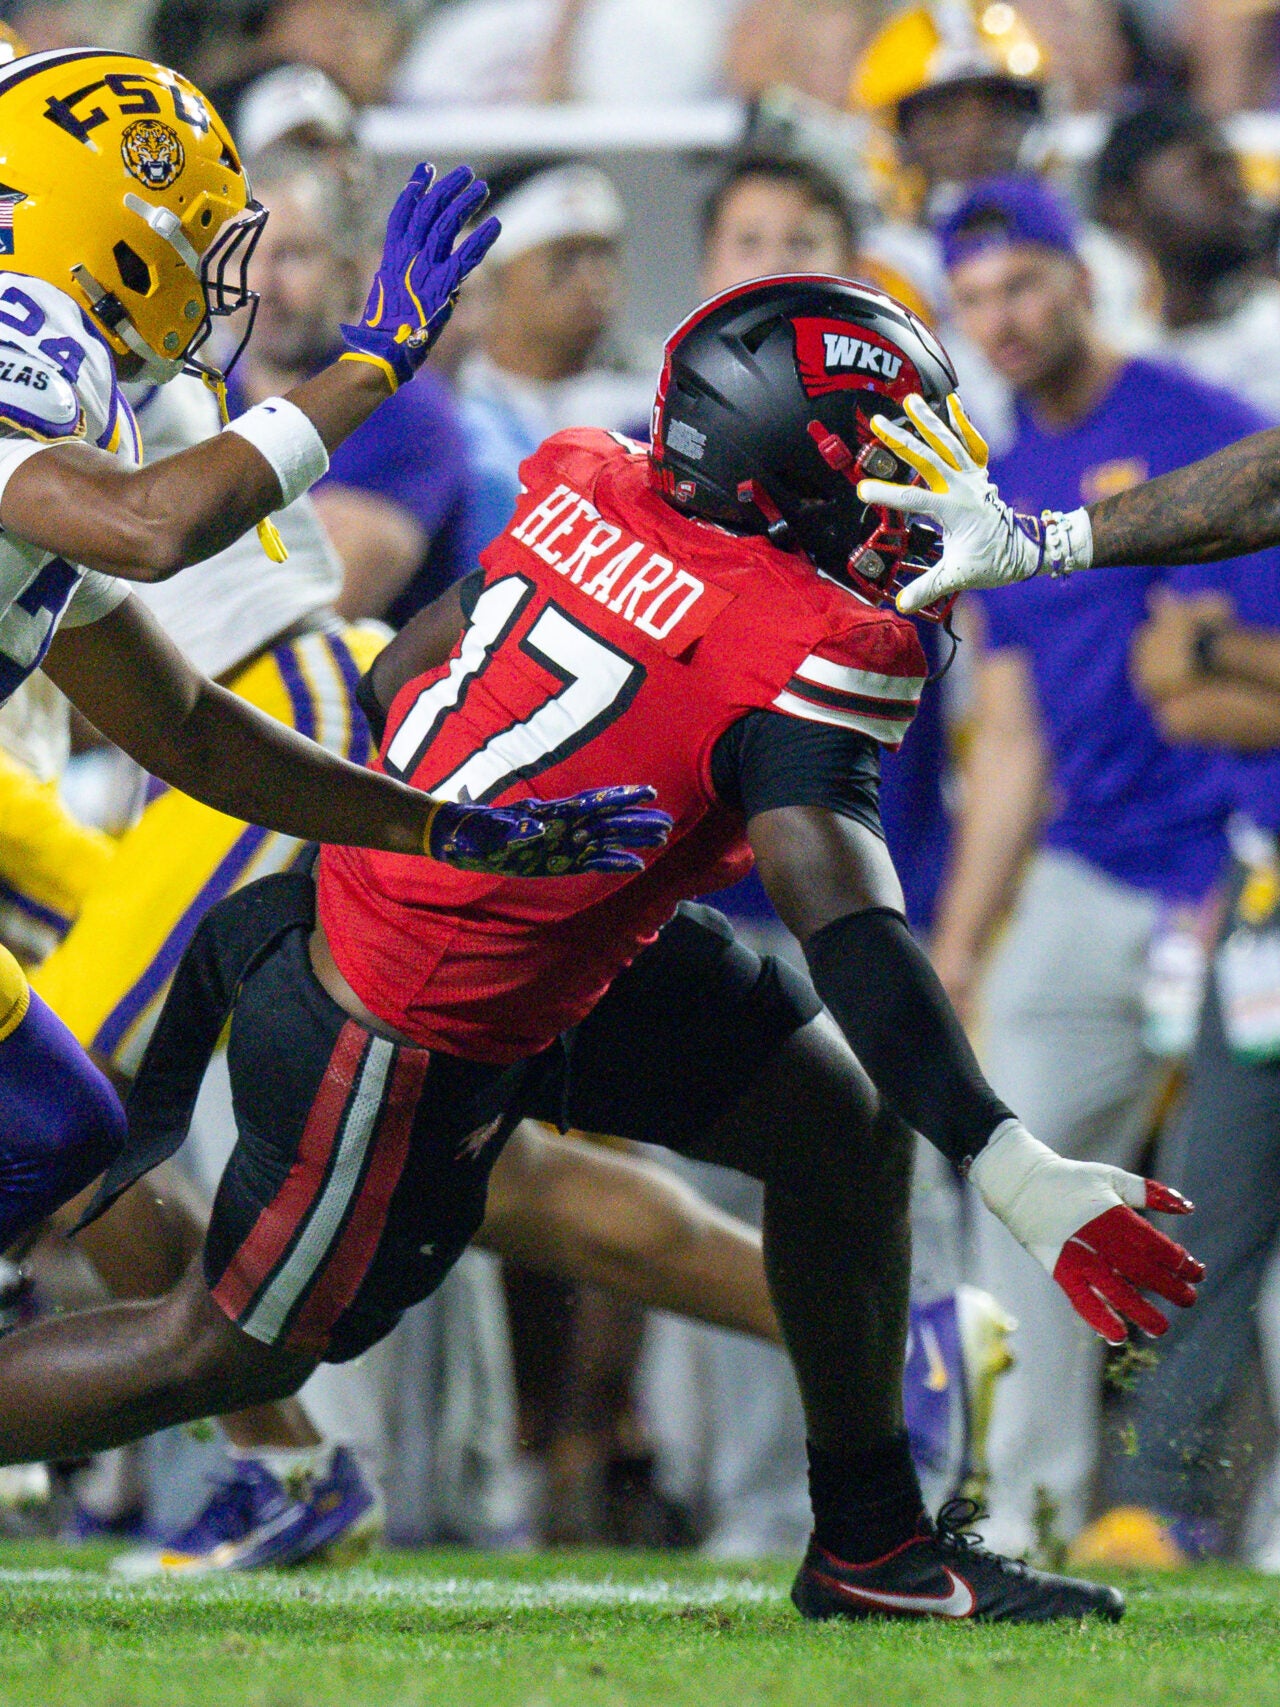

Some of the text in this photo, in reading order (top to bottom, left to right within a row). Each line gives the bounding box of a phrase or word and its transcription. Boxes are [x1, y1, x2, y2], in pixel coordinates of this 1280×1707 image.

[43, 74, 209, 145] LSU
[823, 332, 903, 379] WKU
[510, 483, 705, 641] HERARD
[383, 571, 648, 803] 17
